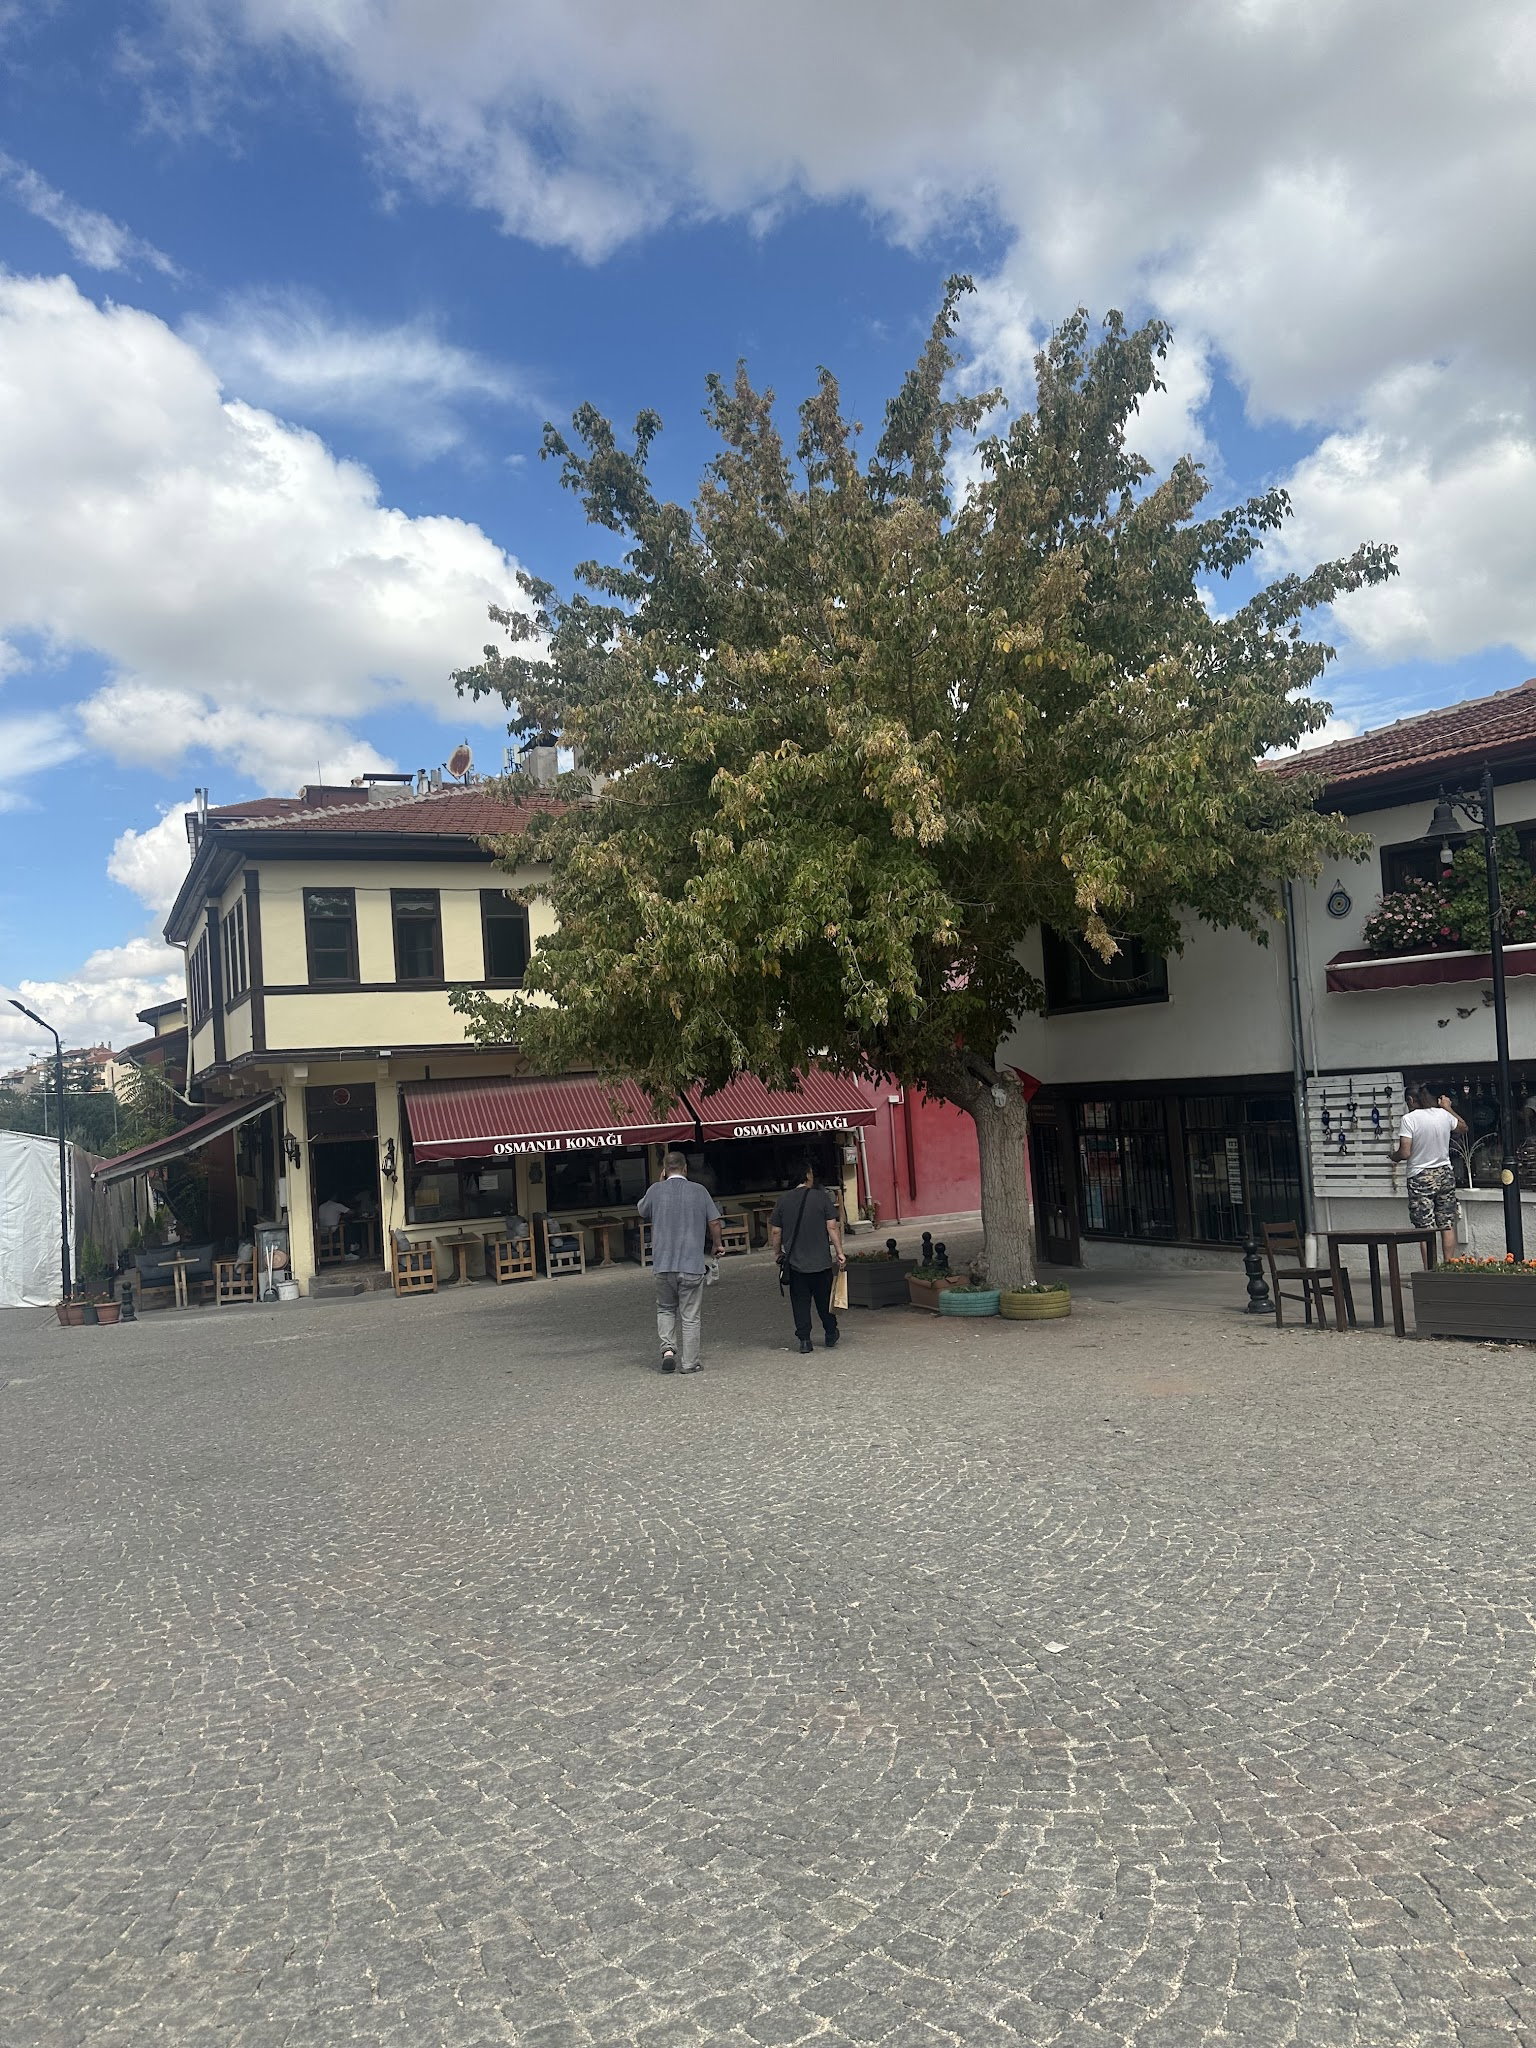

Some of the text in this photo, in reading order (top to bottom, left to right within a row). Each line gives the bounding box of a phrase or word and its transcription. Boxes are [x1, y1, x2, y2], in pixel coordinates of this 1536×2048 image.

[733, 1116, 848, 1137] OSMANLI KONAĞI
[494, 1133, 623, 1154] OSMANLI KONAĞI
